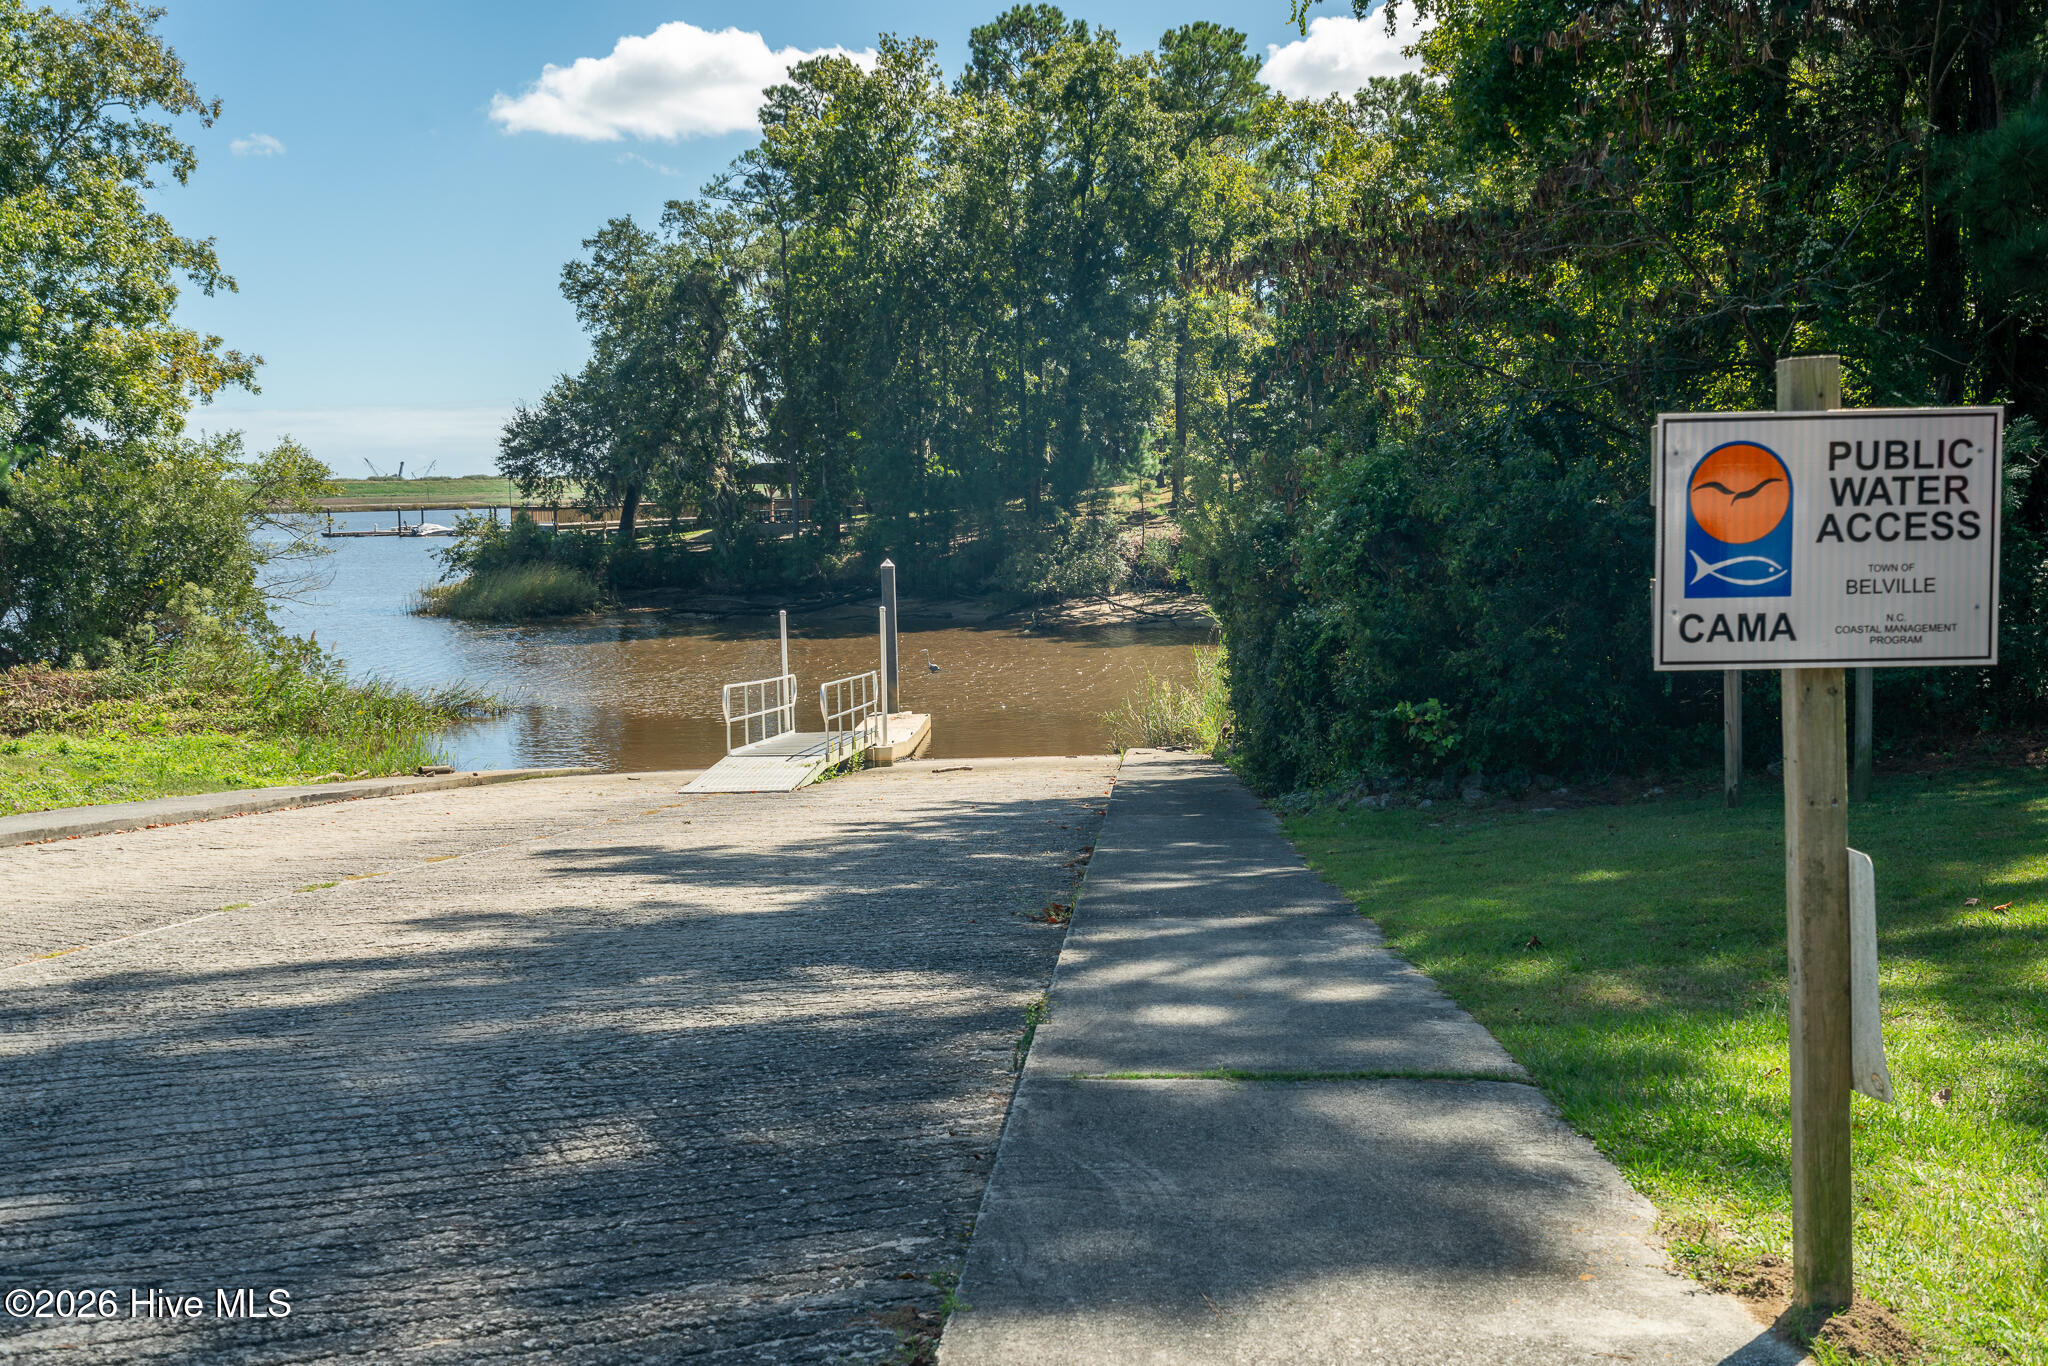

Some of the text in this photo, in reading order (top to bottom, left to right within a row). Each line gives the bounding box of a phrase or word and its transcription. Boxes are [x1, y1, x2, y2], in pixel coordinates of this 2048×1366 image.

[1828, 439, 1974, 471] PUBLIC
[1830, 475, 1970, 507] WATER
[1815, 510, 1981, 544] ACCESS
[1868, 563, 1915, 573] TOWN OF
[1846, 577, 1936, 595] BELVILLE
[1885, 613, 1906, 623] N.C.
[1679, 612, 1797, 644] CAMA
[1835, 623, 1958, 634] COASTAL MANAGEMENT
[1869, 635, 1923, 645] PROGRAM
